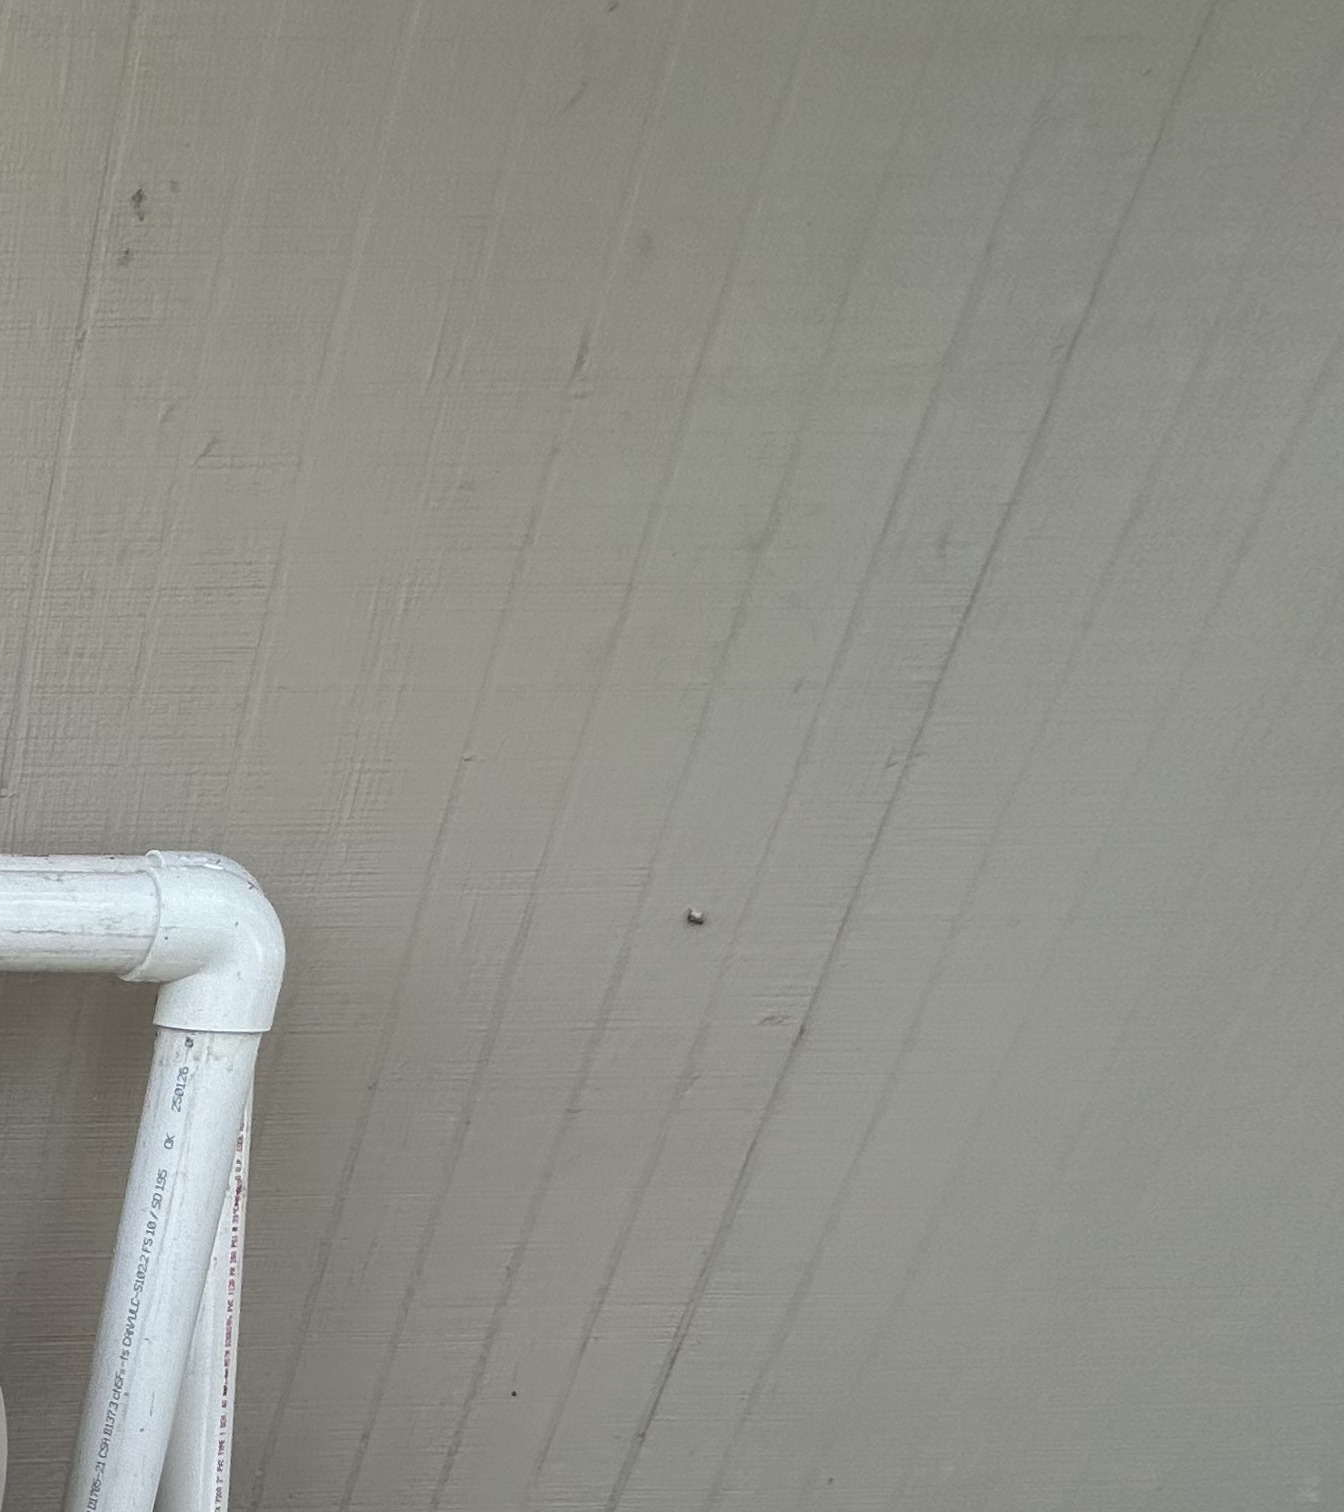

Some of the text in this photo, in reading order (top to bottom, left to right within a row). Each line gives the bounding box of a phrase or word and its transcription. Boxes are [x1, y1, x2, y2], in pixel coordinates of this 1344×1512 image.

[170, 1066, 190, 1113] 250126
[154, 1168, 168, 1191] 195
[151, 1192, 163, 1210] SD
[145, 1220, 157, 1236] 10
[141, 1237, 154, 1254] FS
[97, 1437, 111, 1459] CSA
